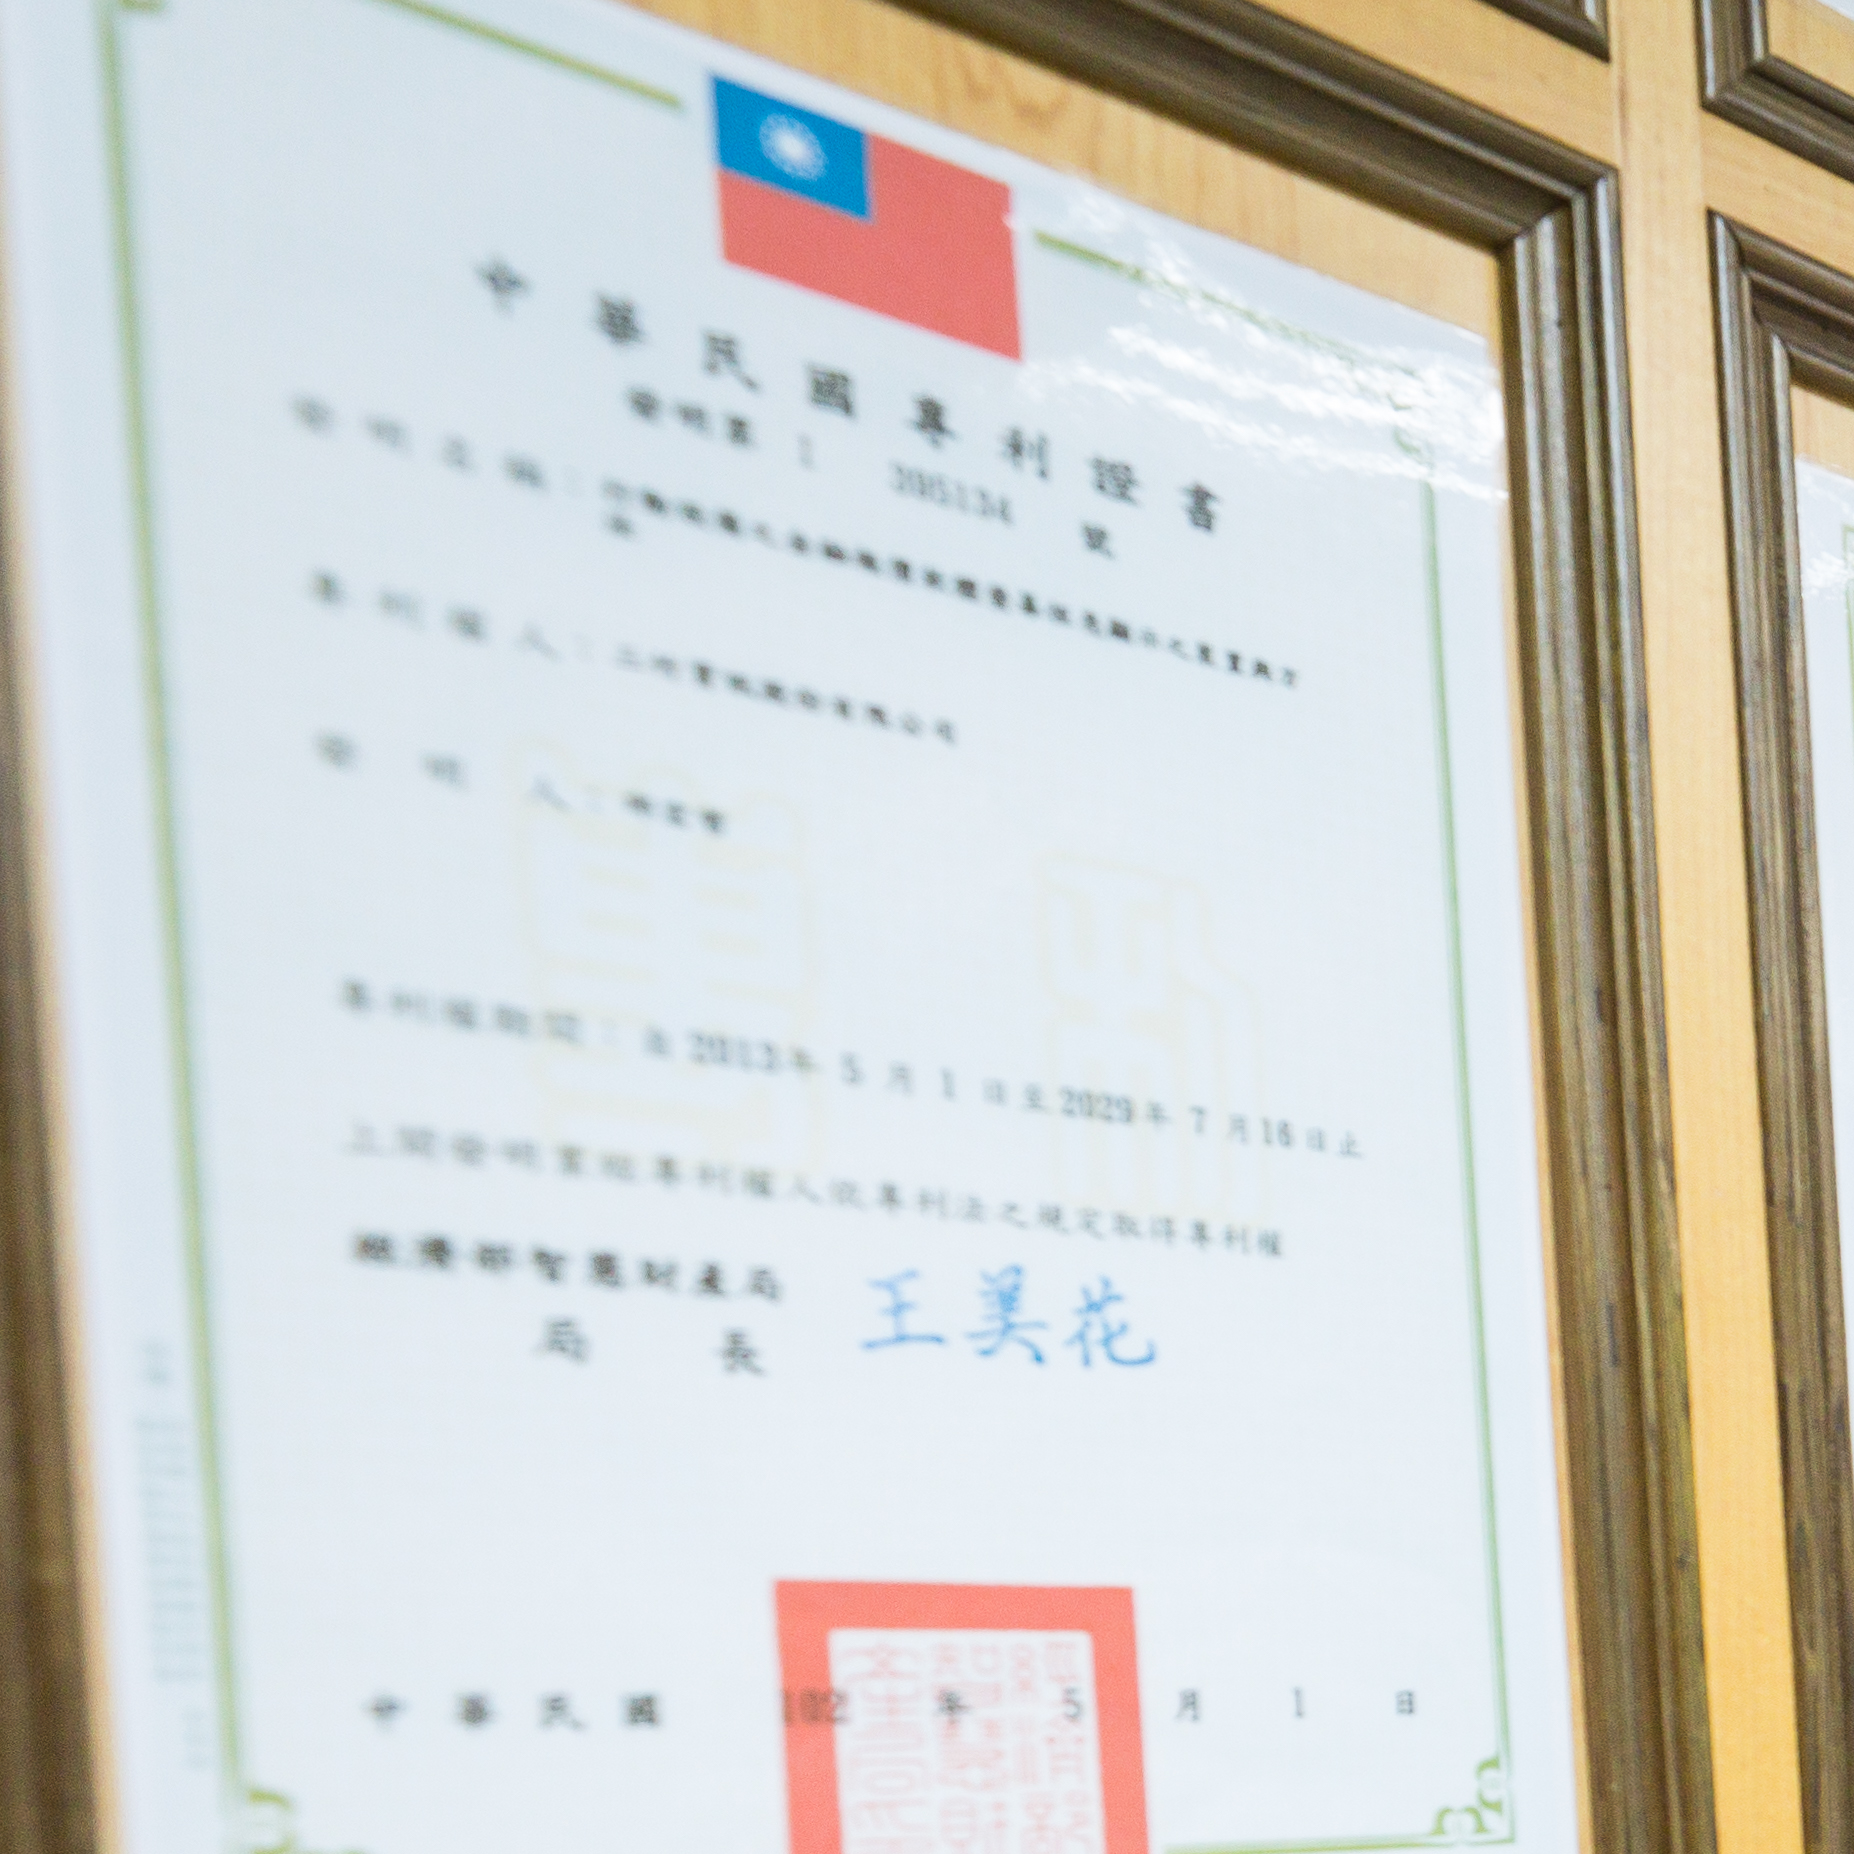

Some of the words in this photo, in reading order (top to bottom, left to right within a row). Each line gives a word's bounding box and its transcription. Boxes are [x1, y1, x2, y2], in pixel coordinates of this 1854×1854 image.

[474, 259, 1219, 534] 中華民國專利證書
[859, 1262, 1158, 1369] 王美花
[366, 1690, 662, 1730] 中華民國
